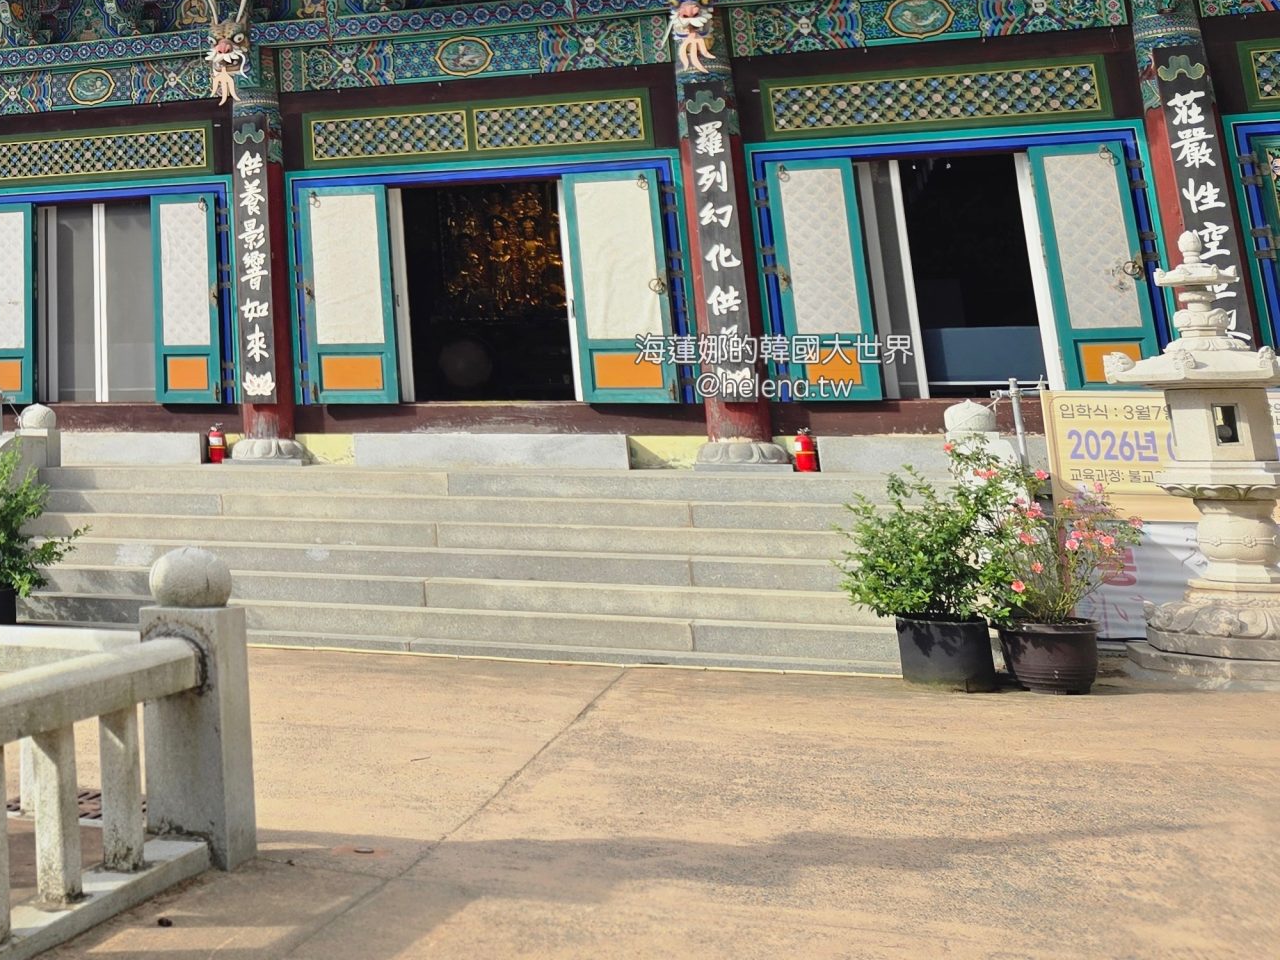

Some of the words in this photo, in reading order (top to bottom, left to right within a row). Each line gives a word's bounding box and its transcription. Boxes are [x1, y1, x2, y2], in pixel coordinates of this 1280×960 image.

[237, 150, 269, 362] 供養影響如來
[694, 121, 744, 358] 羅列幻化供
[1167, 90, 1251, 340] 莊嚴性空
[1059, 404, 1108, 420] 입학식
[1066, 429, 1159, 462] 2026년
[1070, 469, 1124, 484] 교육과정:
